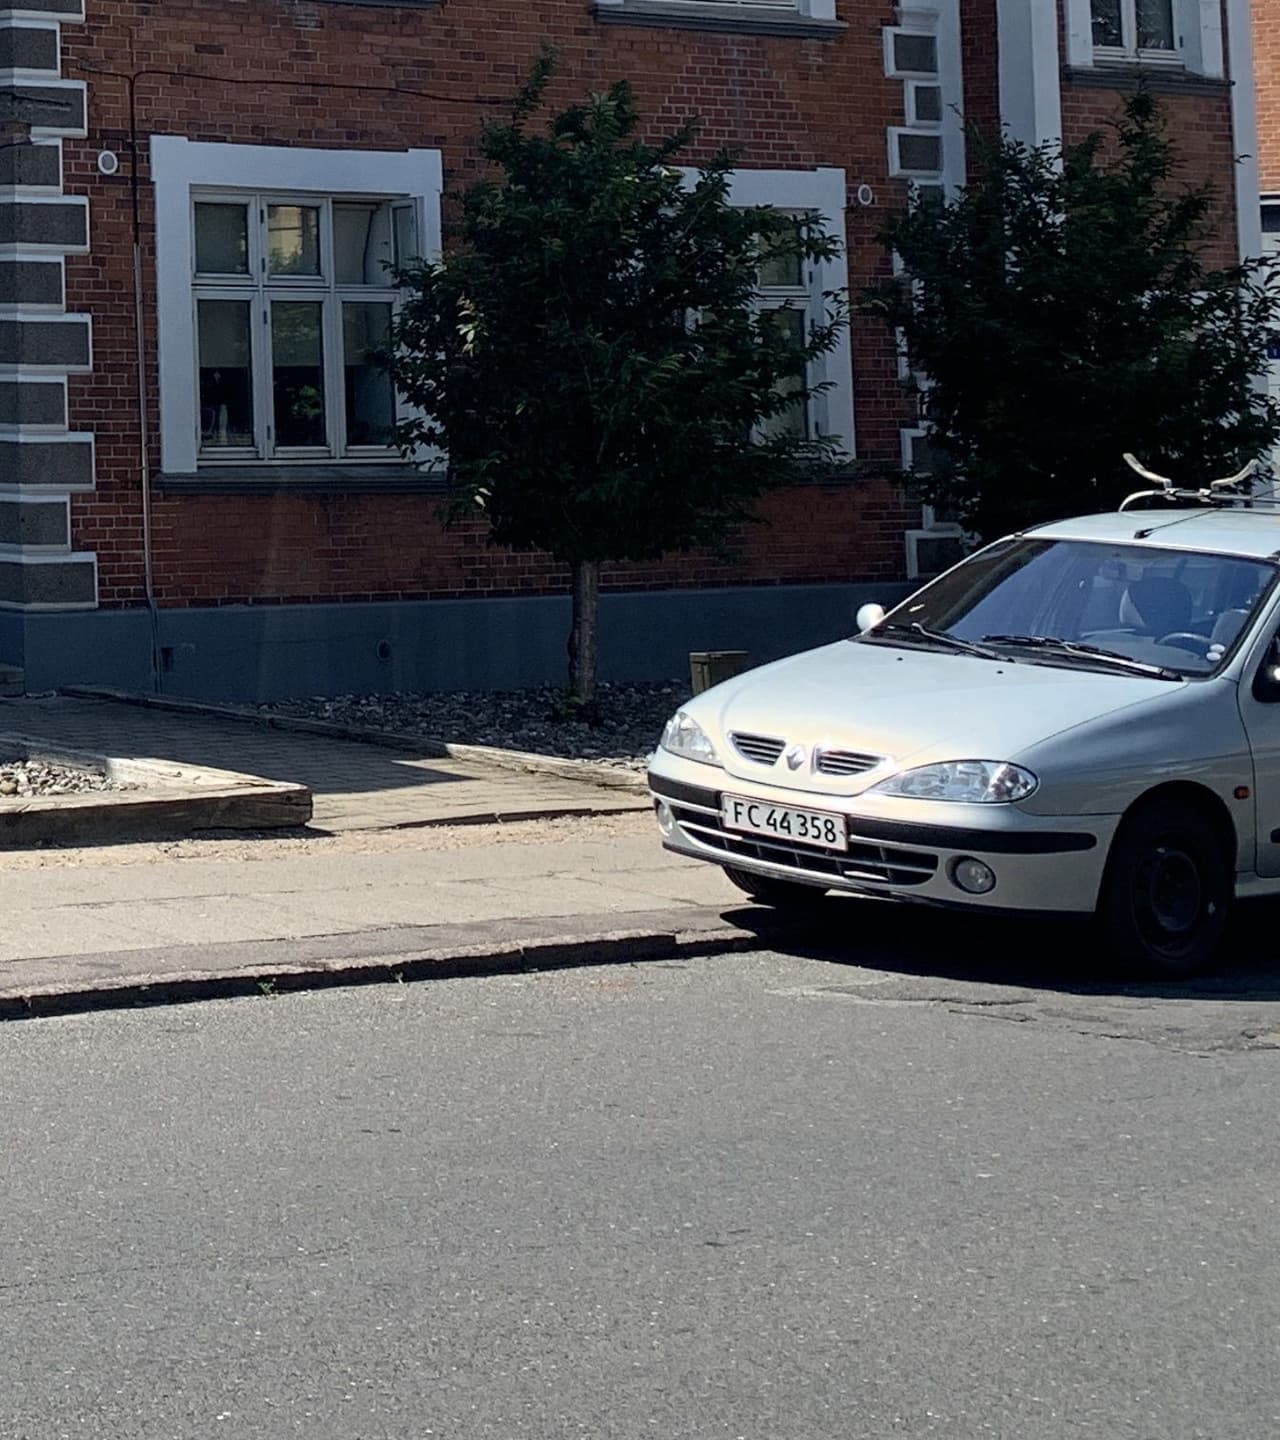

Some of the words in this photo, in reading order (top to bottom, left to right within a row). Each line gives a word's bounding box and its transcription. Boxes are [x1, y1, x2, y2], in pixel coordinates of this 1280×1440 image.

[733, 801, 760, 828] FC
[766, 808, 791, 835] 44
[795, 813, 836, 843] 358
